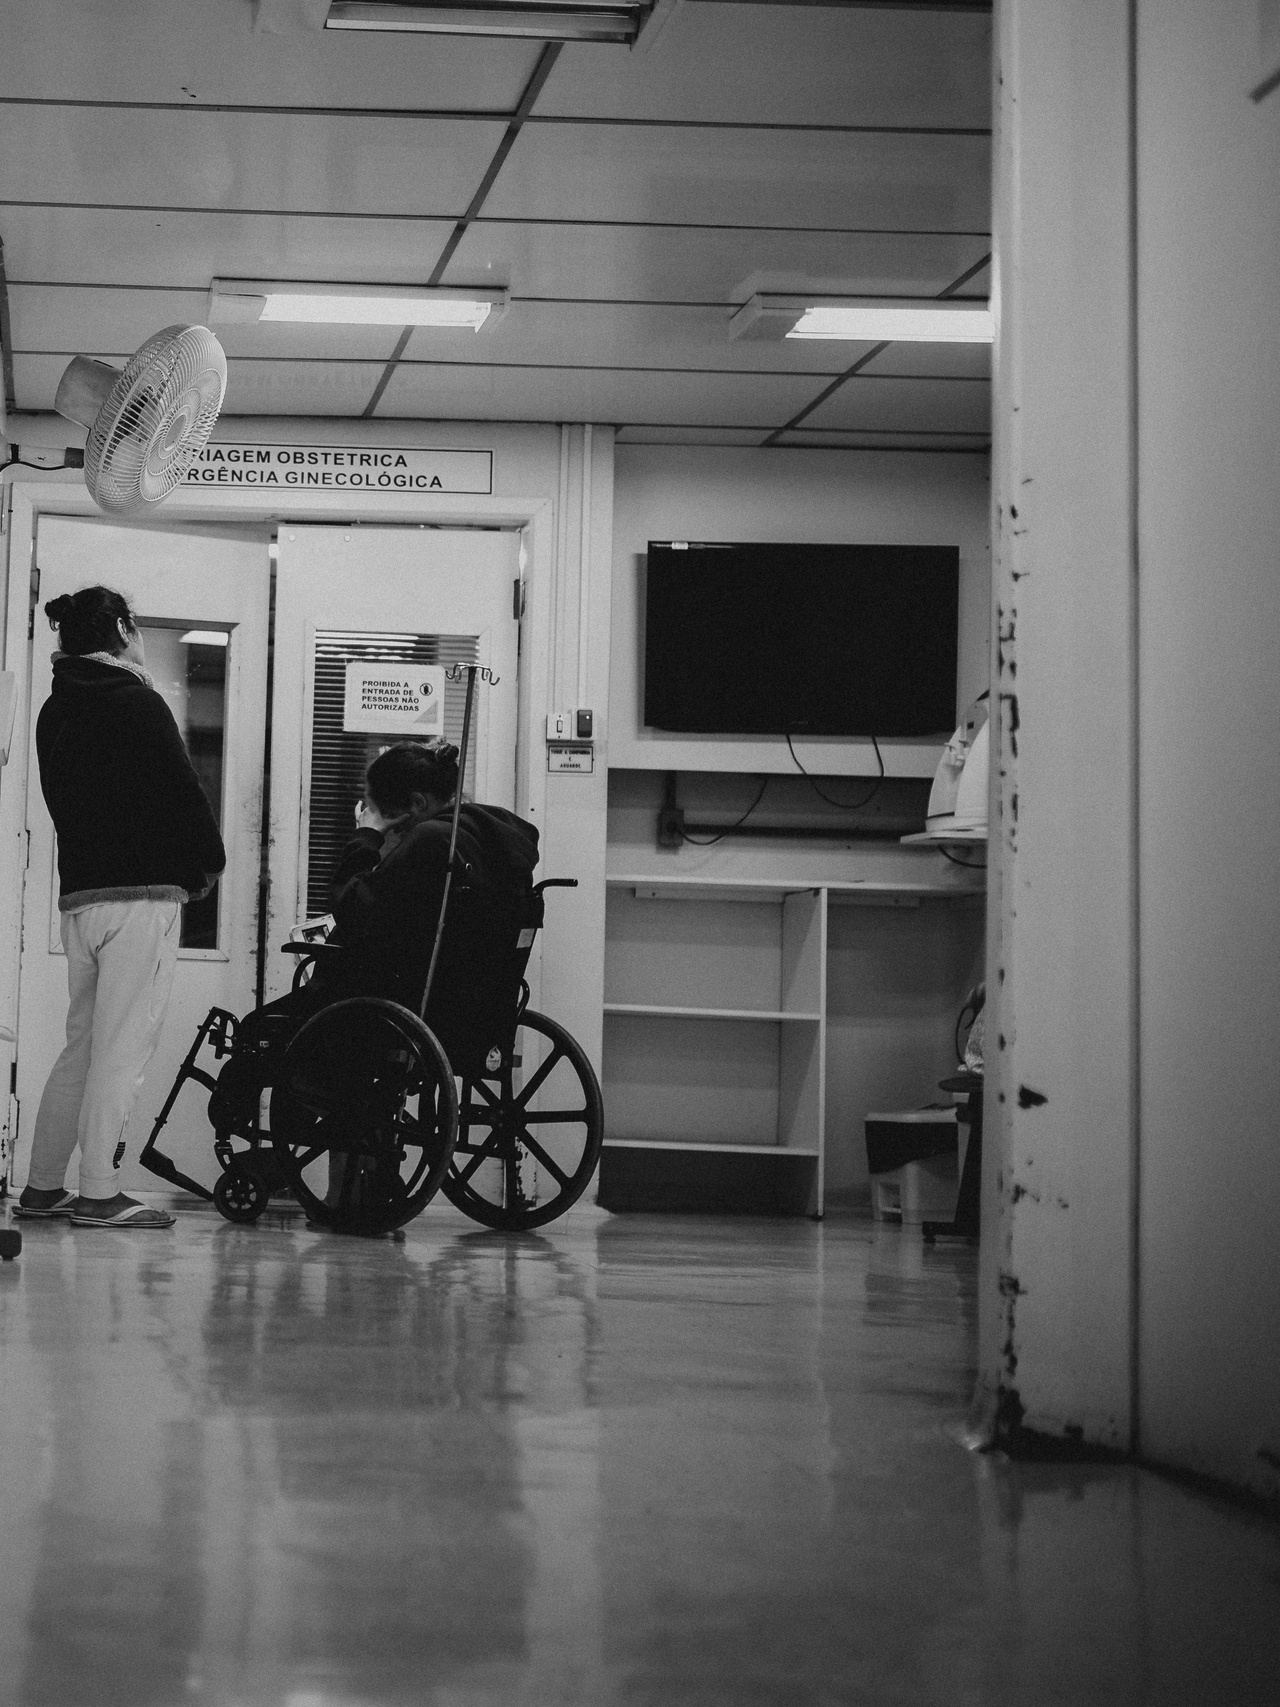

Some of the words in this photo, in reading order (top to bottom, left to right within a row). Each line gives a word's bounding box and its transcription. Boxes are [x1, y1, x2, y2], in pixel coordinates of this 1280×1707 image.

[193, 448, 271, 463] RIAGEM
[277, 451, 408, 467] OBSTETRICA
[186, 466, 279, 483] RGÊNCIA
[285, 471, 443, 488] GINECOLÓGICA
[362, 680, 401, 688] PROIBIDA
[361, 688, 401, 696] ENTRADA
[361, 695, 400, 704] PESSOAS
[361, 703, 420, 712] AUTORIZADAS
